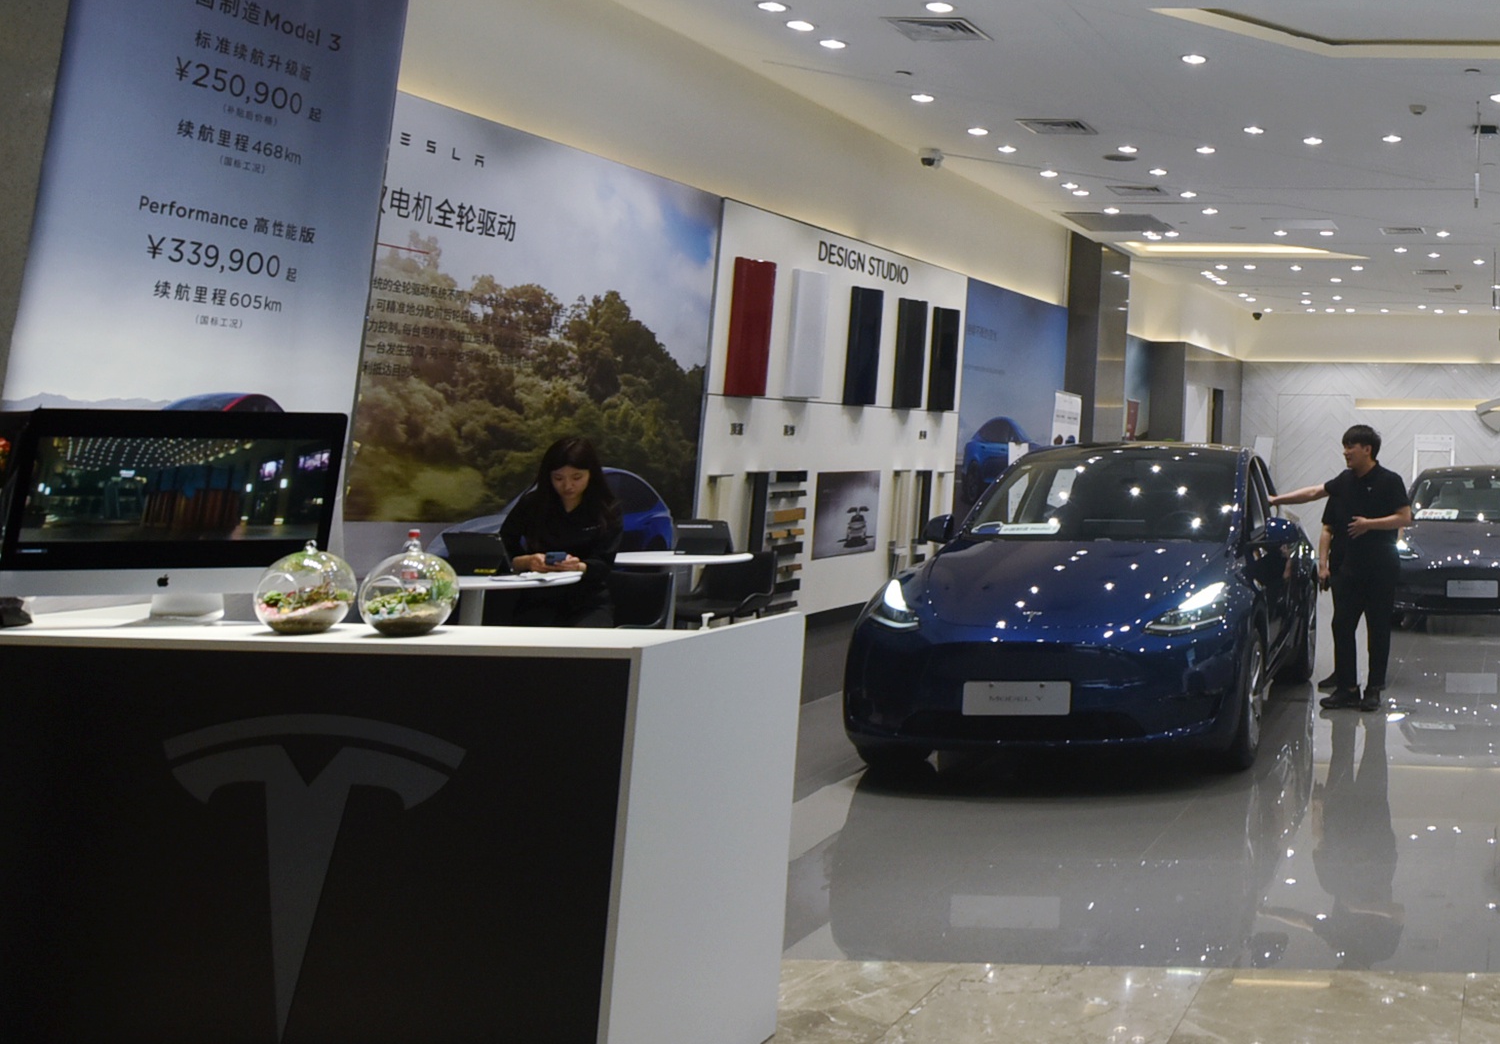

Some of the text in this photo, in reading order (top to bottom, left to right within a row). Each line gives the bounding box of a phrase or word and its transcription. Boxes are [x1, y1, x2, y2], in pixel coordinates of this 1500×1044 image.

[194, 29, 312, 83] 标准续航升级版
[327, 33, 342, 52] 3
[175, 56, 322, 123] ¥250,900 起
[177, 119, 302, 165] 续航里程468km
[139, 195, 316, 244] Performance 高性能版
[146, 234, 298, 283] ¥339,900 起
[818, 240, 909, 285] DESIGN STUDIO
[153, 280, 282, 313] 续航里程605km
